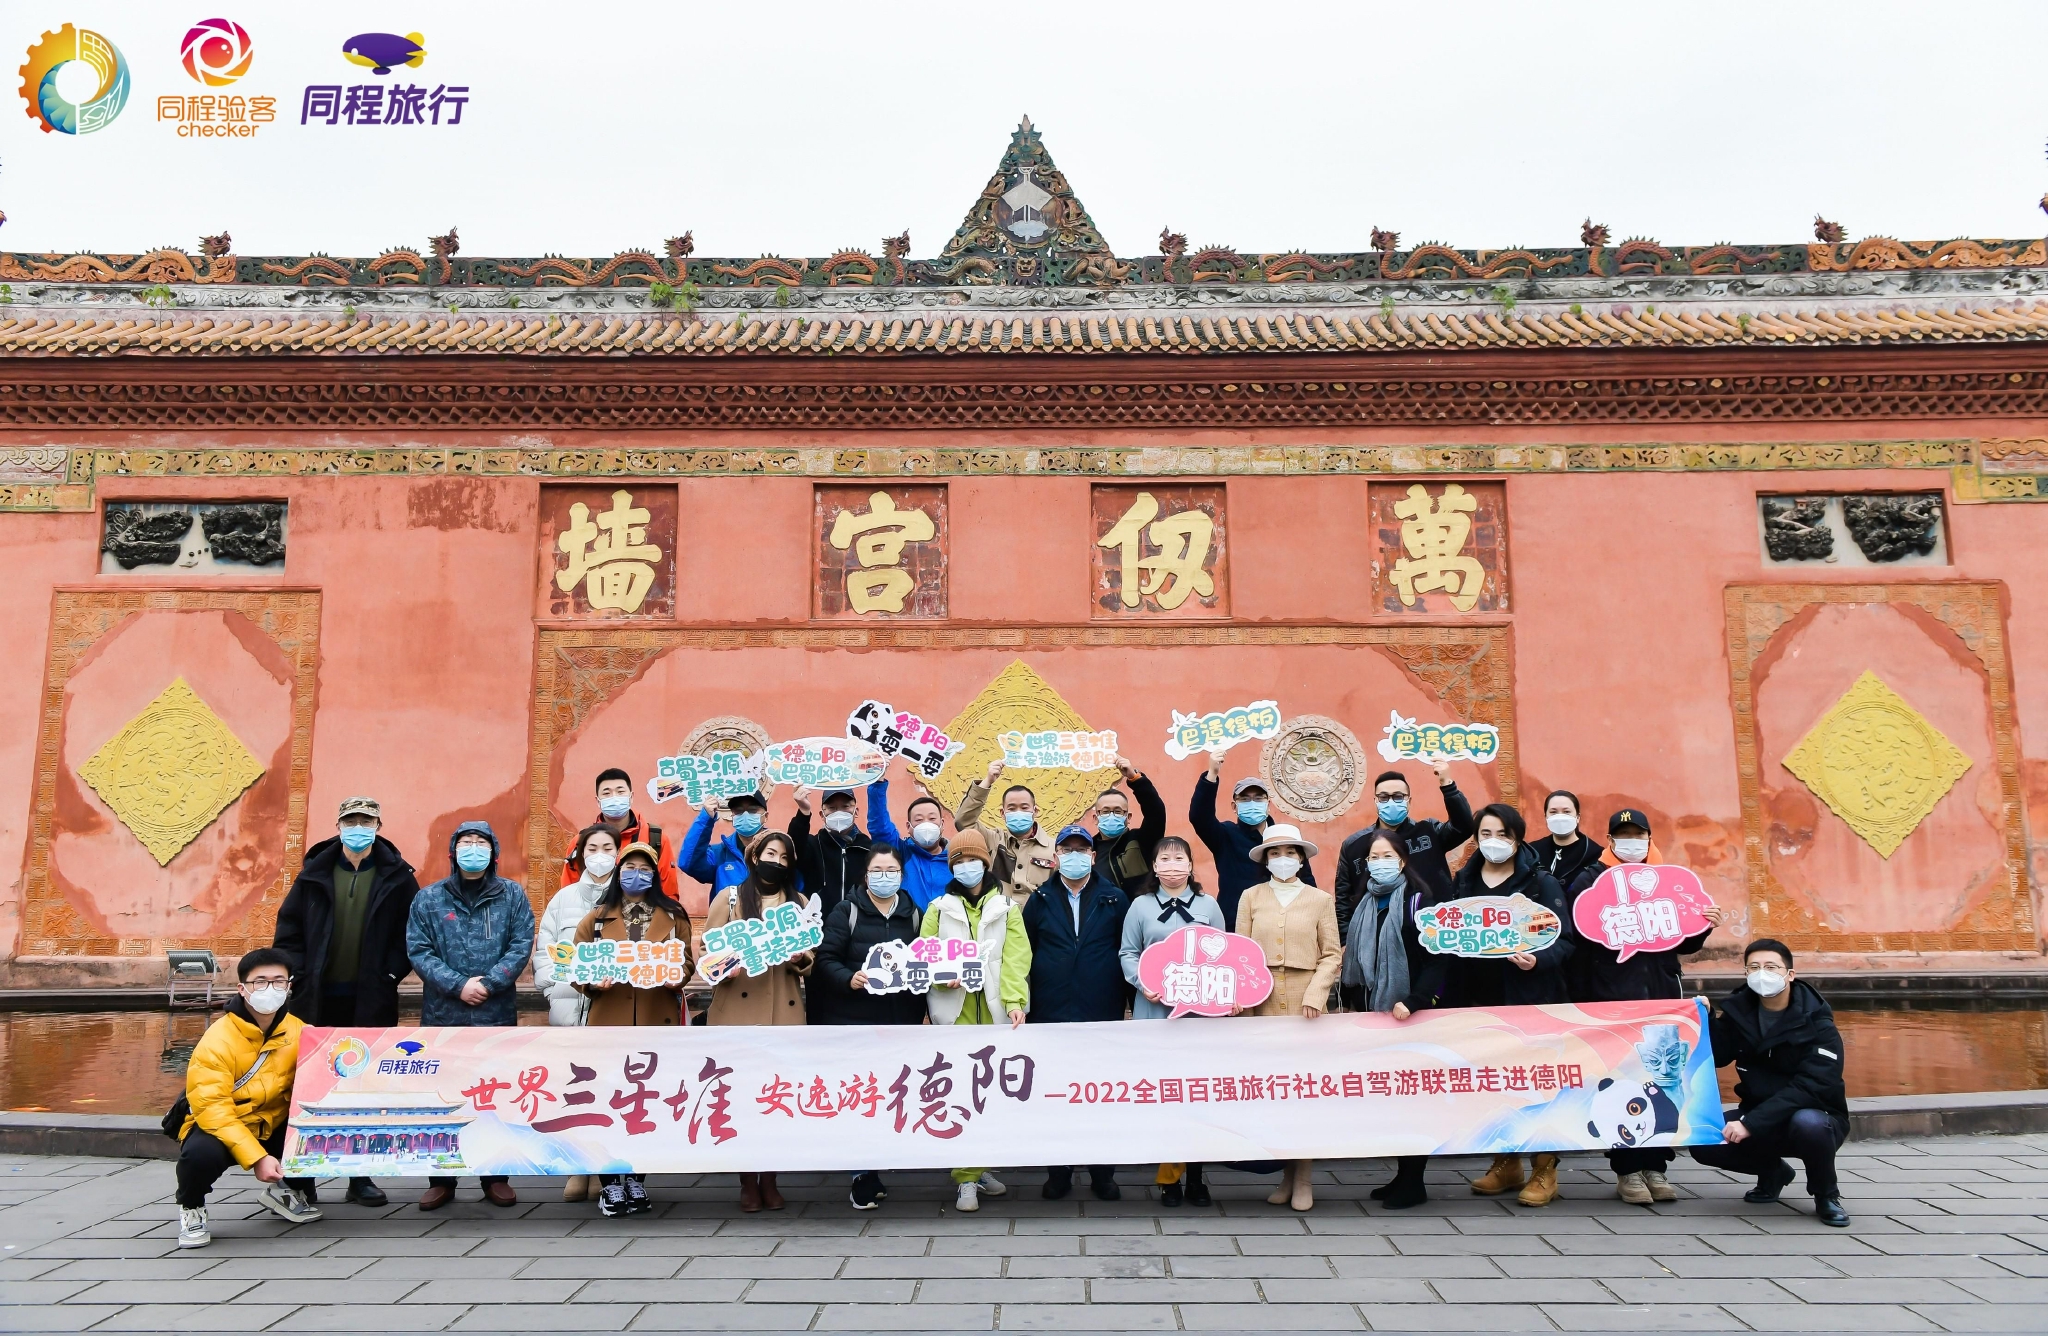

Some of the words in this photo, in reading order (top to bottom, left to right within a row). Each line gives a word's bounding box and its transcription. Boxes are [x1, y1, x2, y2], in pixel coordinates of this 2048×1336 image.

[556, 489, 662, 614] 墙
[1390, 484, 1485, 612] 萬
[895, 713, 948, 751] 德阳
[1181, 706, 1275, 745] 巴适得板
[768, 744, 846, 764] 大德如阳
[879, 725, 945, 777] 耍一耍
[1026, 731, 1116, 751] 世界三星堆
[1396, 730, 1492, 752] 巴适得板
[659, 753, 742, 782] 古蜀之源
[1023, 750, 1116, 769] 安逸游德阳
[781, 763, 851, 784] 巴蜀风华
[686, 778, 757, 804] 重装之都
[705, 904, 802, 953] 古蜀之源
[1420, 907, 1511, 929] 大德如阳
[1599, 898, 1681, 948] 德阳
[577, 941, 683, 963] 世界三星堆
[743, 926, 822, 975] 重装之都
[911, 938, 978, 964] 德阳
[1438, 928, 1521, 953] 巴蜀风华
[574, 963, 682, 986] 安逸游德阳
[905, 960, 983, 992] 耍一耍
[1162, 962, 1237, 1006] 德阳
[376, 1059, 441, 1075] 同程旅行
[460, 1051, 738, 1146] 世界三星堆
[755, 1045, 1036, 1140] 安逸游德阳
